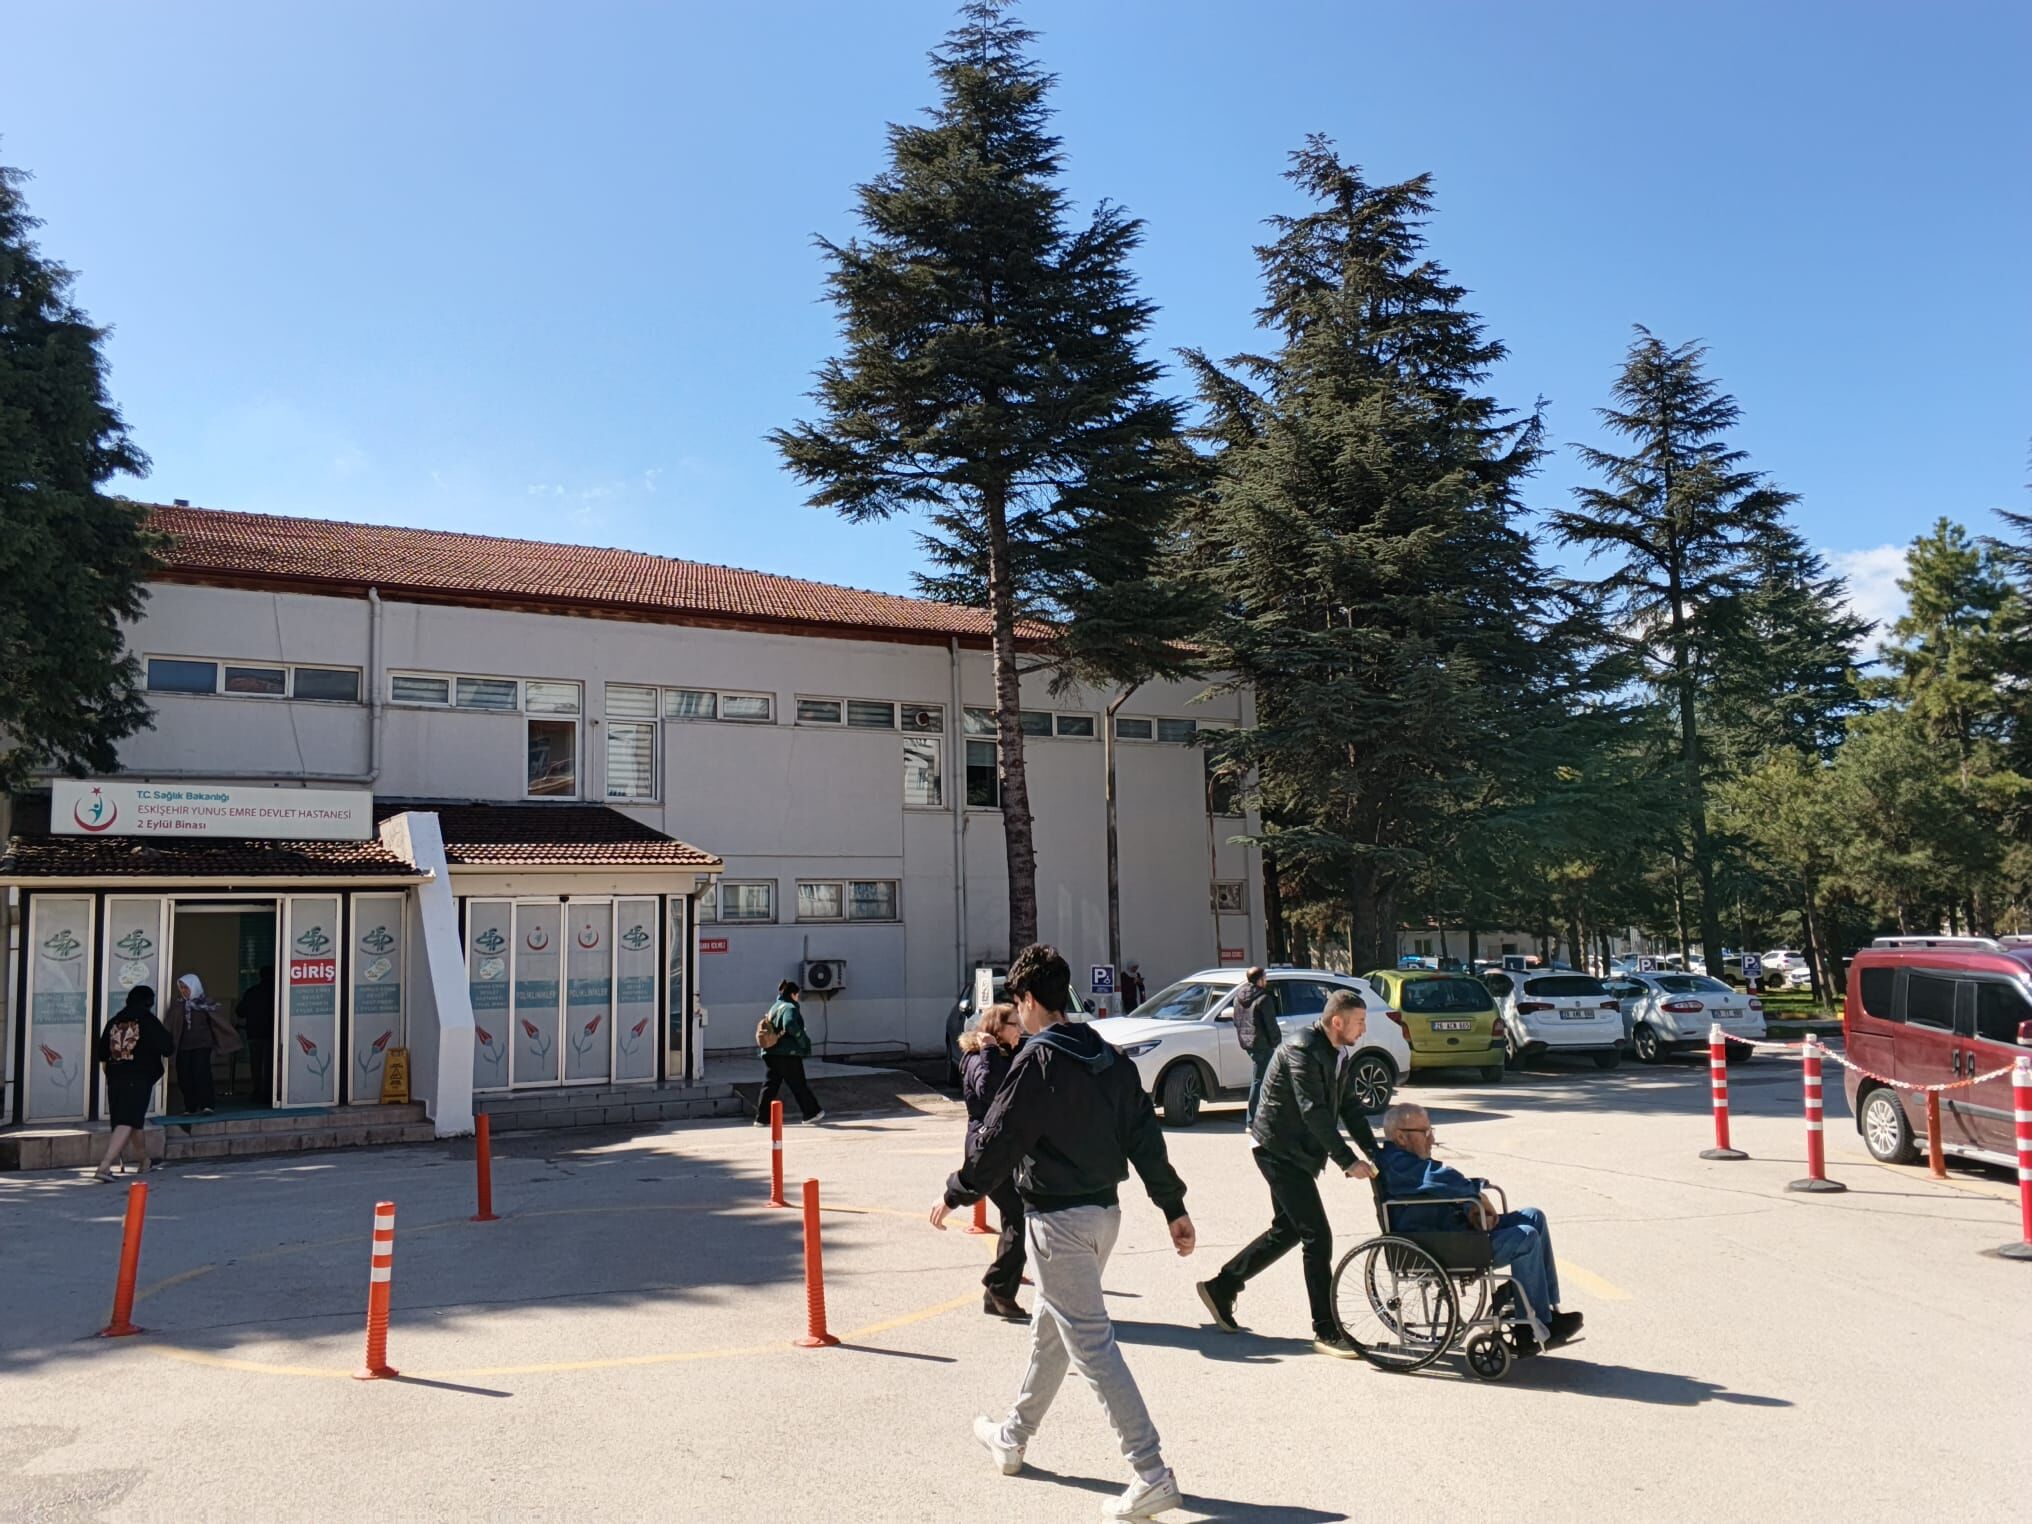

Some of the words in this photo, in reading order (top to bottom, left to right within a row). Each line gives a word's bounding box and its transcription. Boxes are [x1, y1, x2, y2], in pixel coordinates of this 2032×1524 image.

[153, 790, 183, 801] Sağlık
[185, 791, 230, 802] Bakanlığı
[137, 804, 189, 816] ESKİŞEHİR
[191, 807, 227, 816] YUNUS
[229, 808, 256, 817] EMRE
[259, 808, 295, 818] DEVLET
[298, 809, 351, 819] HASTANESİ
[137, 819, 144, 829] 2
[146, 819, 172, 831] Eylül
[175, 820, 206, 829] Binası
[1744, 956, 1755, 968] P
[291, 963, 335, 981] GİRİŞ
[1094, 968, 1107, 984] P
